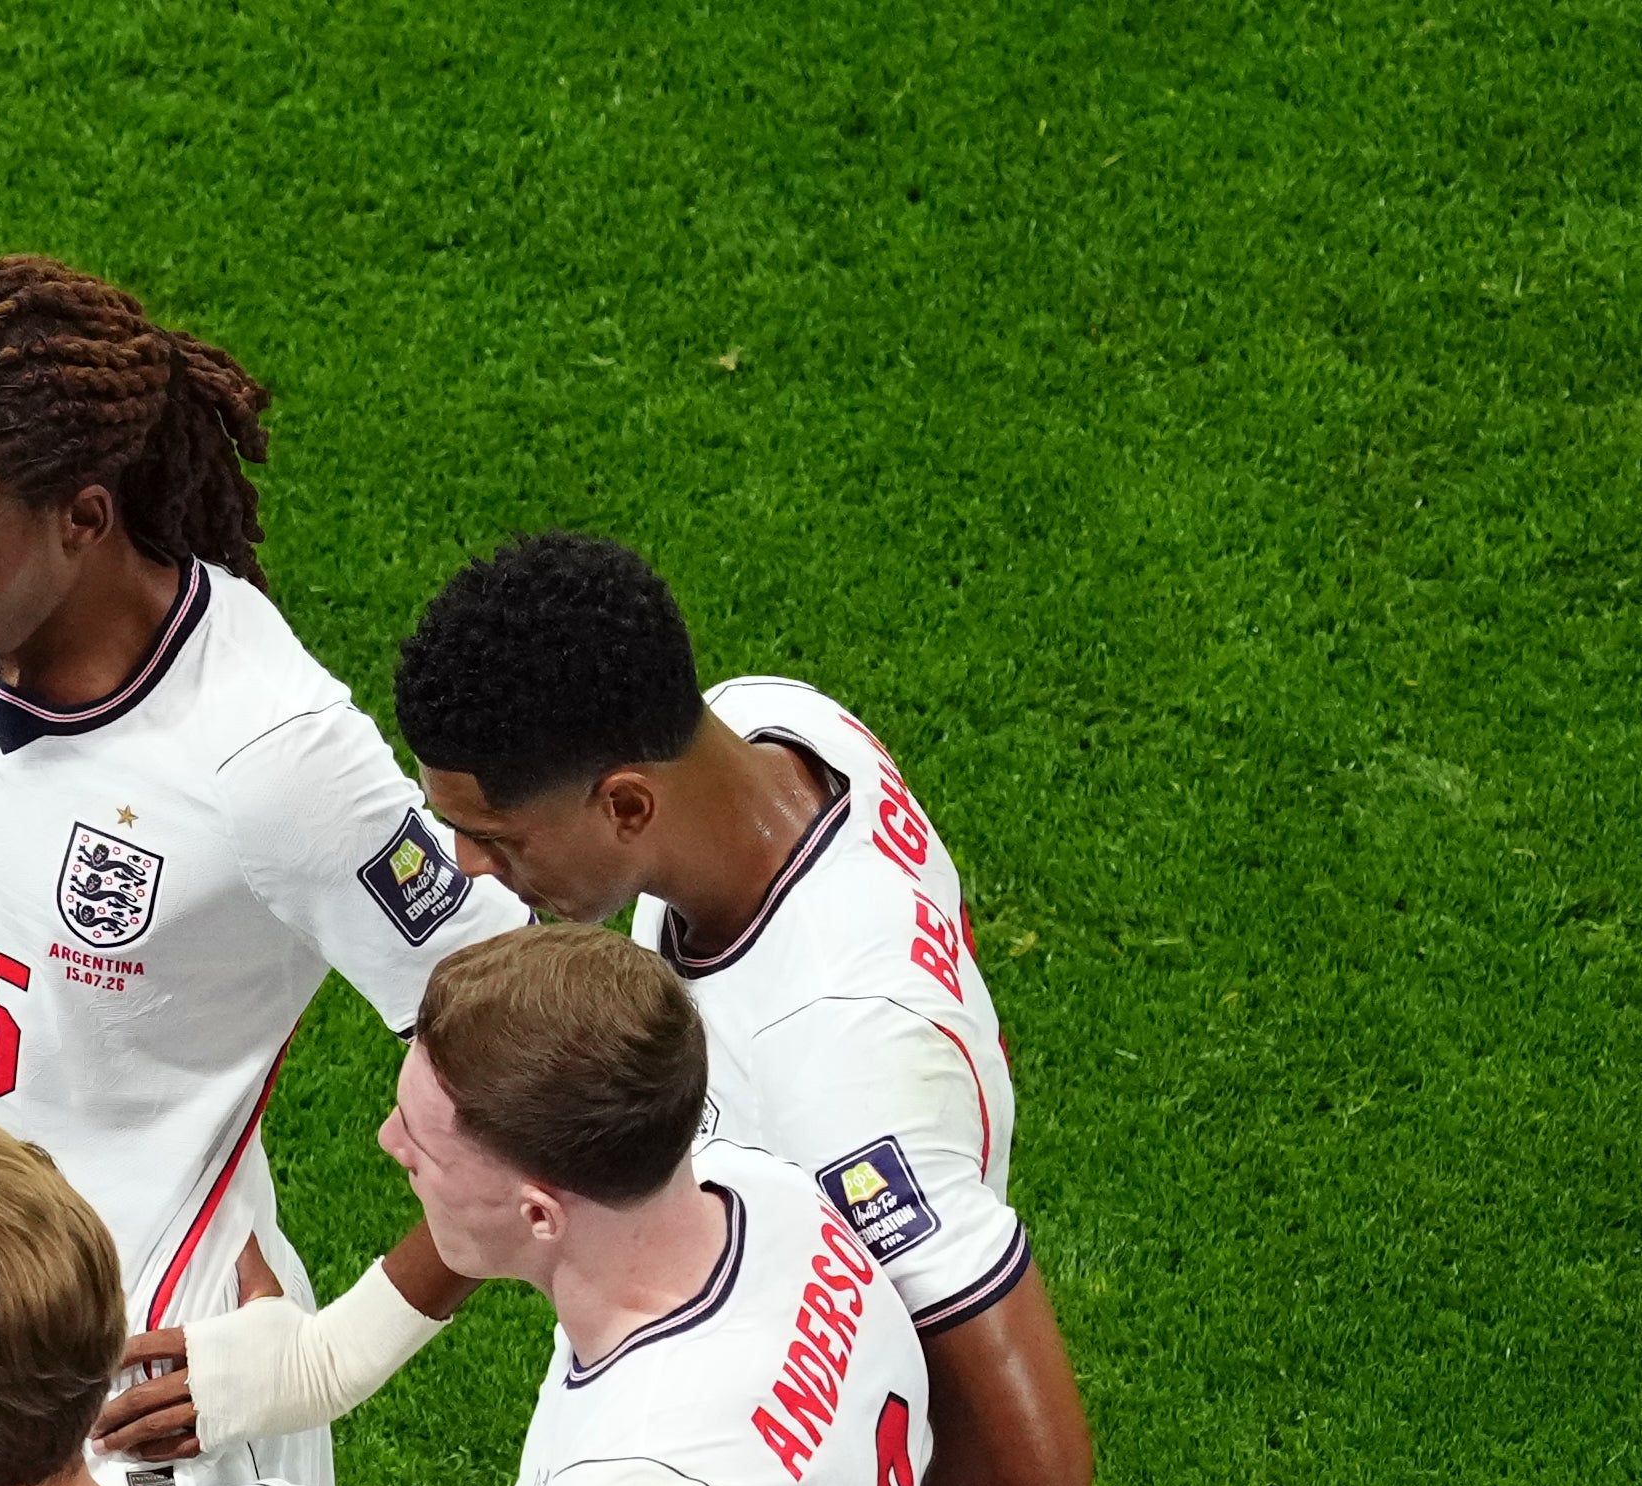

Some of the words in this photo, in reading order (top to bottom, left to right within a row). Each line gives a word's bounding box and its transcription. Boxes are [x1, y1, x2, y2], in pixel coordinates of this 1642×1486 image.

[48, 942, 145, 975] ARGENTINA
[66, 966, 125, 991] 15.07.26
[880, 1233, 905, 1250] FIFA
